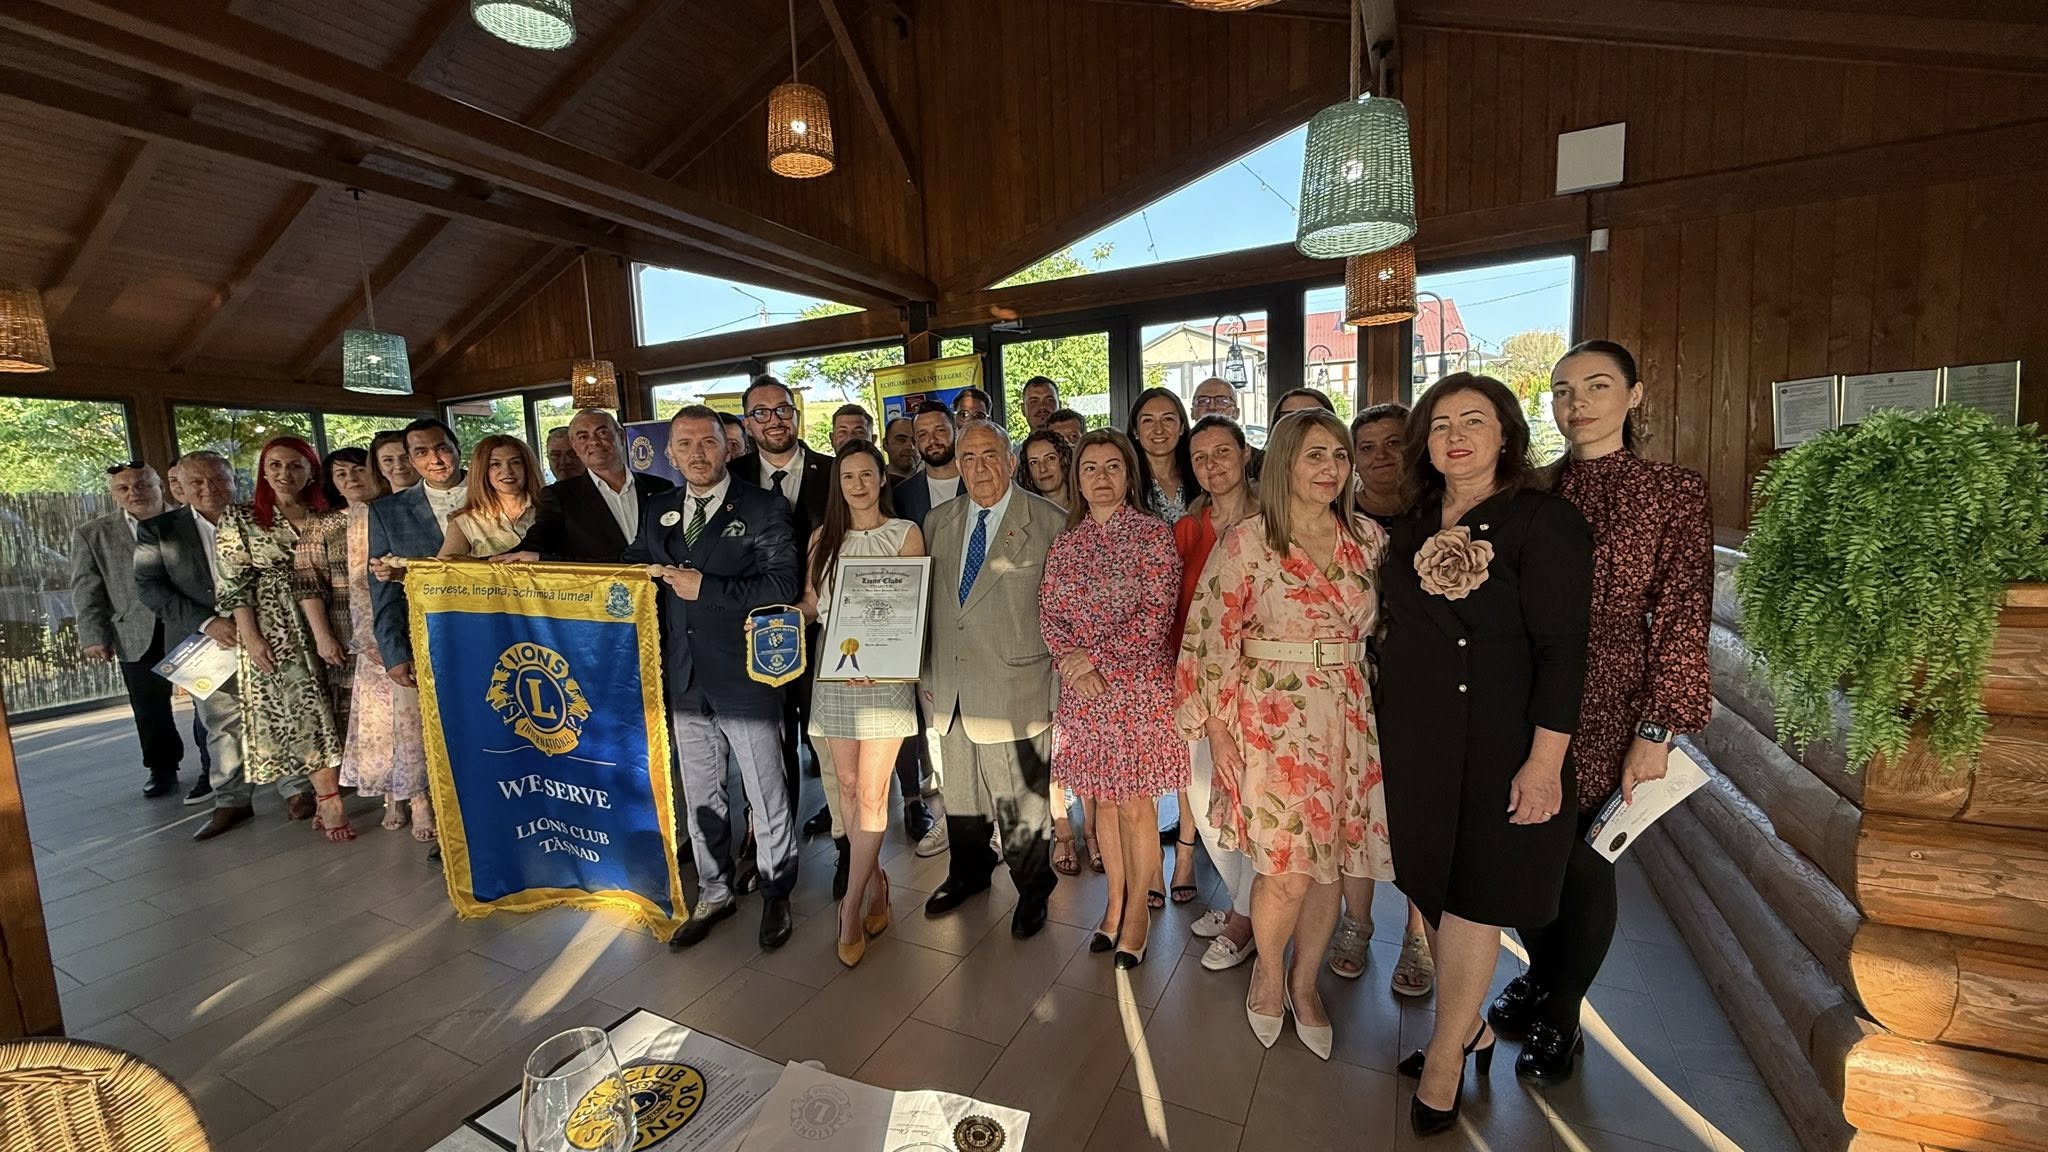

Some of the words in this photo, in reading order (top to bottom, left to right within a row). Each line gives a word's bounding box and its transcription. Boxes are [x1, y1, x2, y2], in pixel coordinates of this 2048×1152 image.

[423, 584, 470, 598] Servește,
[472, 585, 510, 597] Inspiră,
[557, 590, 593, 602] lumea!
[506, 645, 566, 675] LIONS
[526, 678, 557, 719] L
[521, 722, 575, 750] INTERNATIONAL
[497, 774, 544, 800] WE
[544, 778, 611, 809] SERVE
[515, 817, 569, 840] LIONS
[569, 825, 610, 845] CLUB
[623, 1066, 687, 1083] CLUB
[793, 1121, 831, 1138] LIONS
